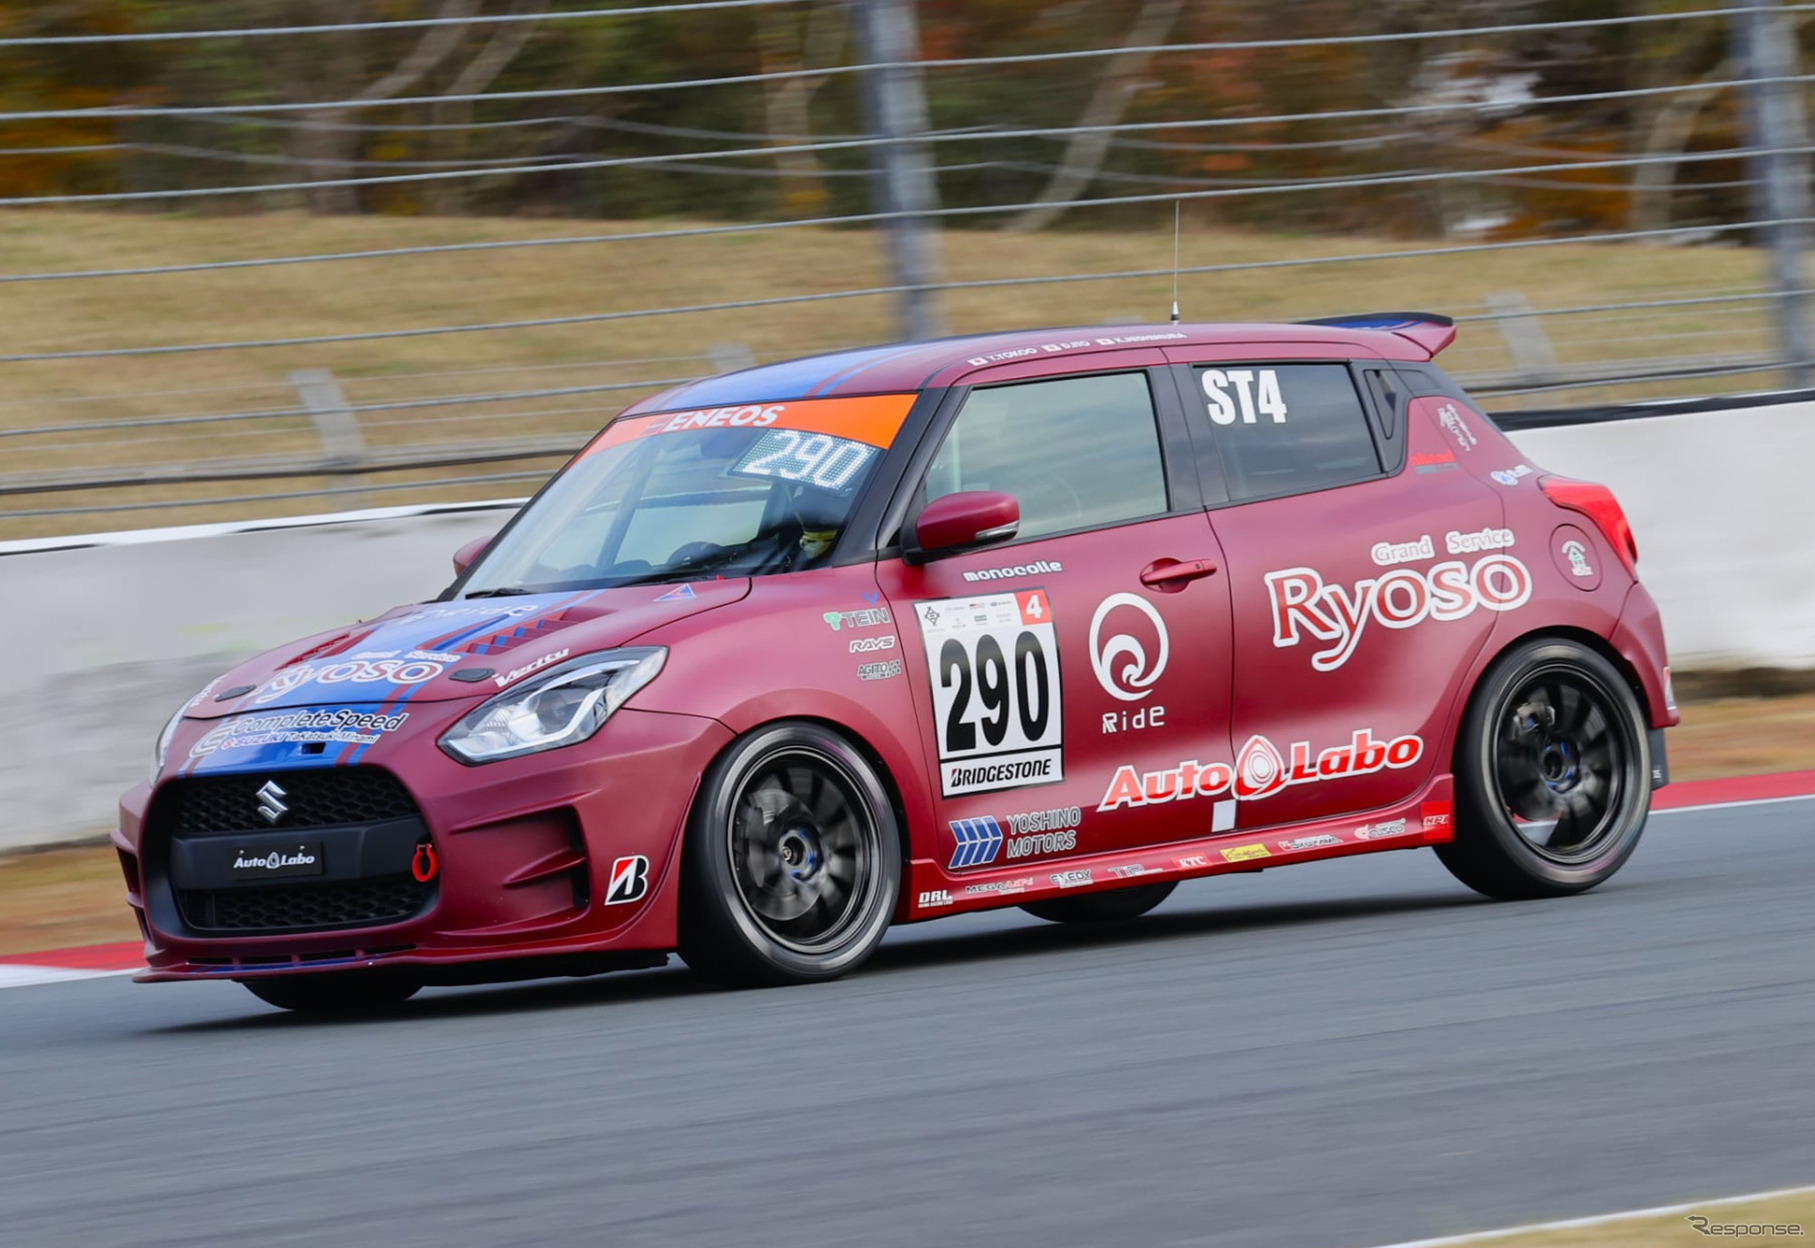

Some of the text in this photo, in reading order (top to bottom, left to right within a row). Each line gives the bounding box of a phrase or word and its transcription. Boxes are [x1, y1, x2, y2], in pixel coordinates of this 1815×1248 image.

[1202, 369, 1287, 425] ST4
[662, 404, 785, 432] ENEOS
[742, 429, 869, 488] 290
[1371, 527, 1515, 566] Grand Service
[962, 560, 1063, 583] monocolle
[840, 607, 891, 628] TEIN
[1025, 594, 1043, 619] 4
[1264, 555, 1533, 672] Ryoso
[849, 635, 895, 653] RAYS
[858, 661, 889, 677] AGITO
[940, 631, 1049, 752] 290
[1101, 705, 1165, 734] Ride
[235, 732, 288, 747] SUZUKI
[950, 758, 1052, 788] BRIDGESTONE
[1096, 728, 1424, 812] Auto Labo
[1006, 806, 1082, 835] YOSHINO
[1006, 831, 1077, 858] MOTORS
[233, 852, 316, 869] Auto Labo
[1178, 855, 1207, 869] KTC
[1049, 869, 1092, 885] EXEDY
[918, 889, 954, 903] DRL
